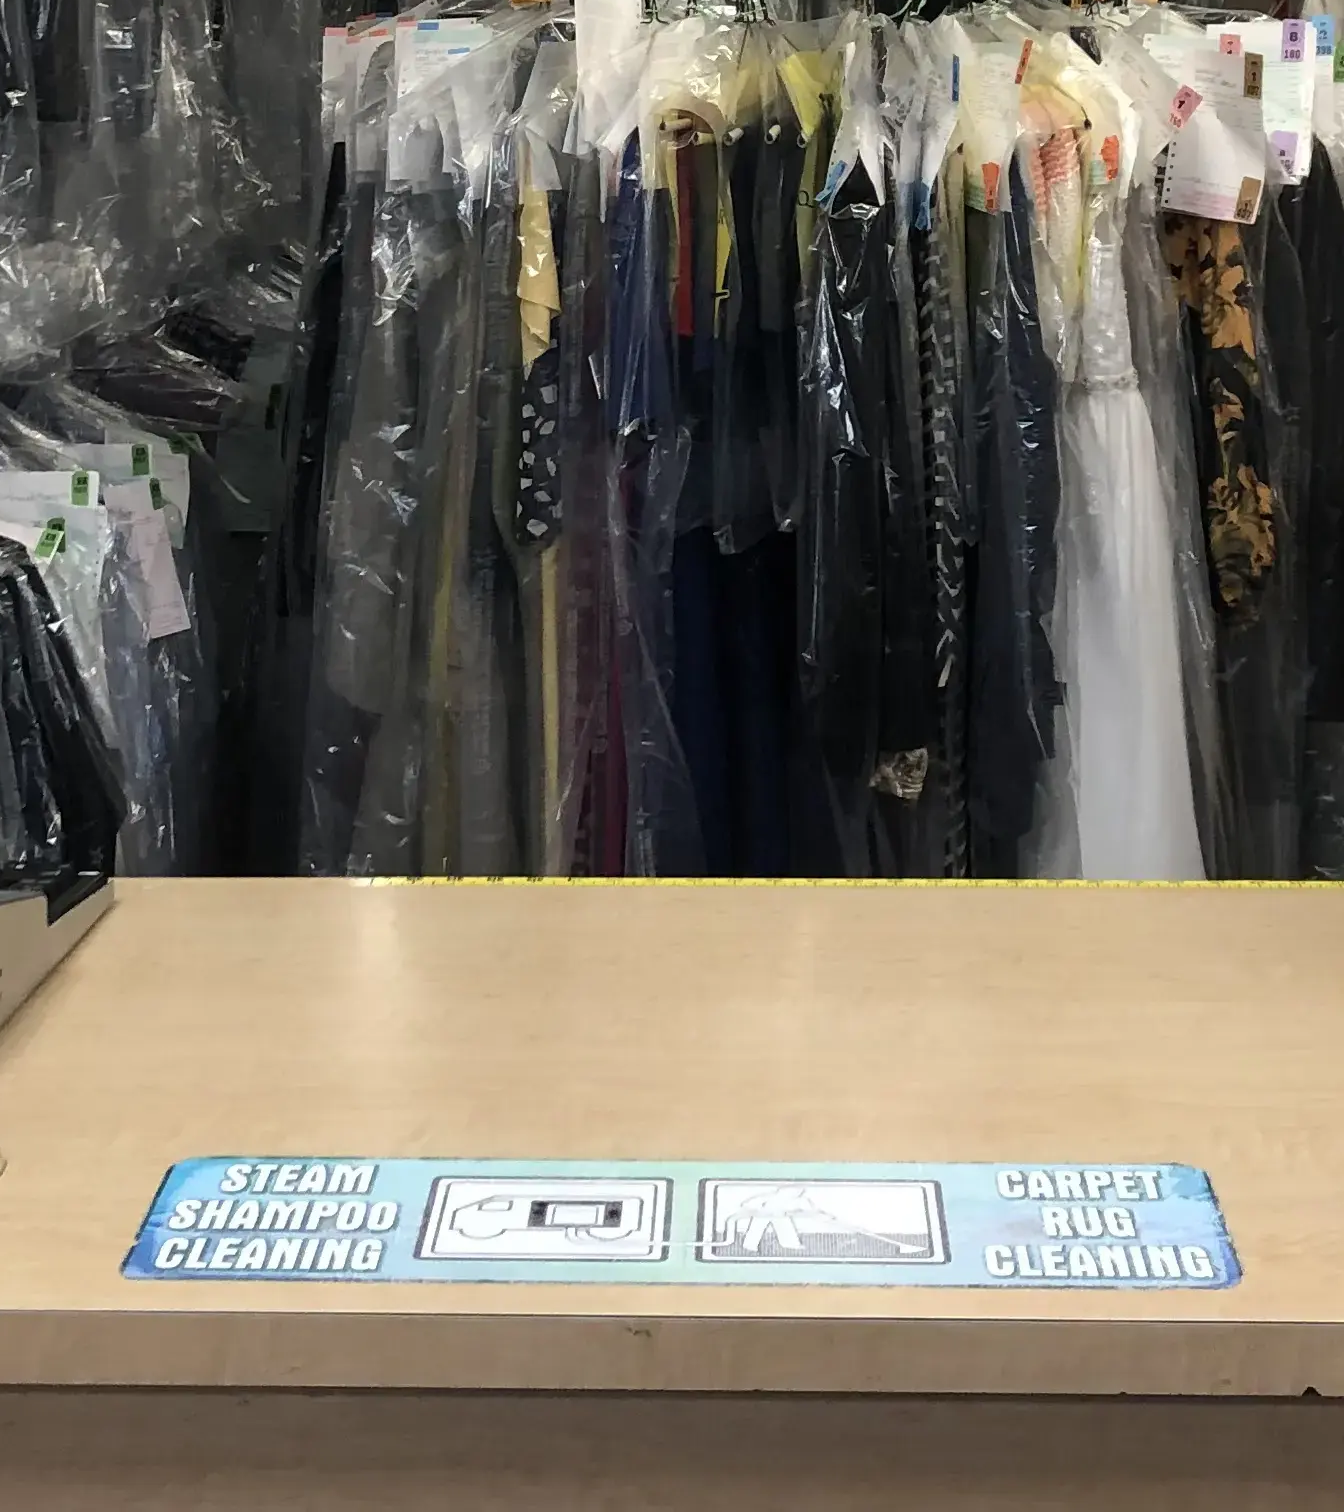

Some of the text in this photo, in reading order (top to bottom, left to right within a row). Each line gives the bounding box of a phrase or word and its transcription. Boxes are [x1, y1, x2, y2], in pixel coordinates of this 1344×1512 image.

[219, 1164, 379, 1194] STEAM
[996, 1169, 1162, 1201] CARPET
[169, 1199, 400, 1232] SHAMPOO
[1041, 1206, 1137, 1239] RUG
[154, 1237, 383, 1272] CLEANING
[984, 1244, 1215, 1280] CLEANING
